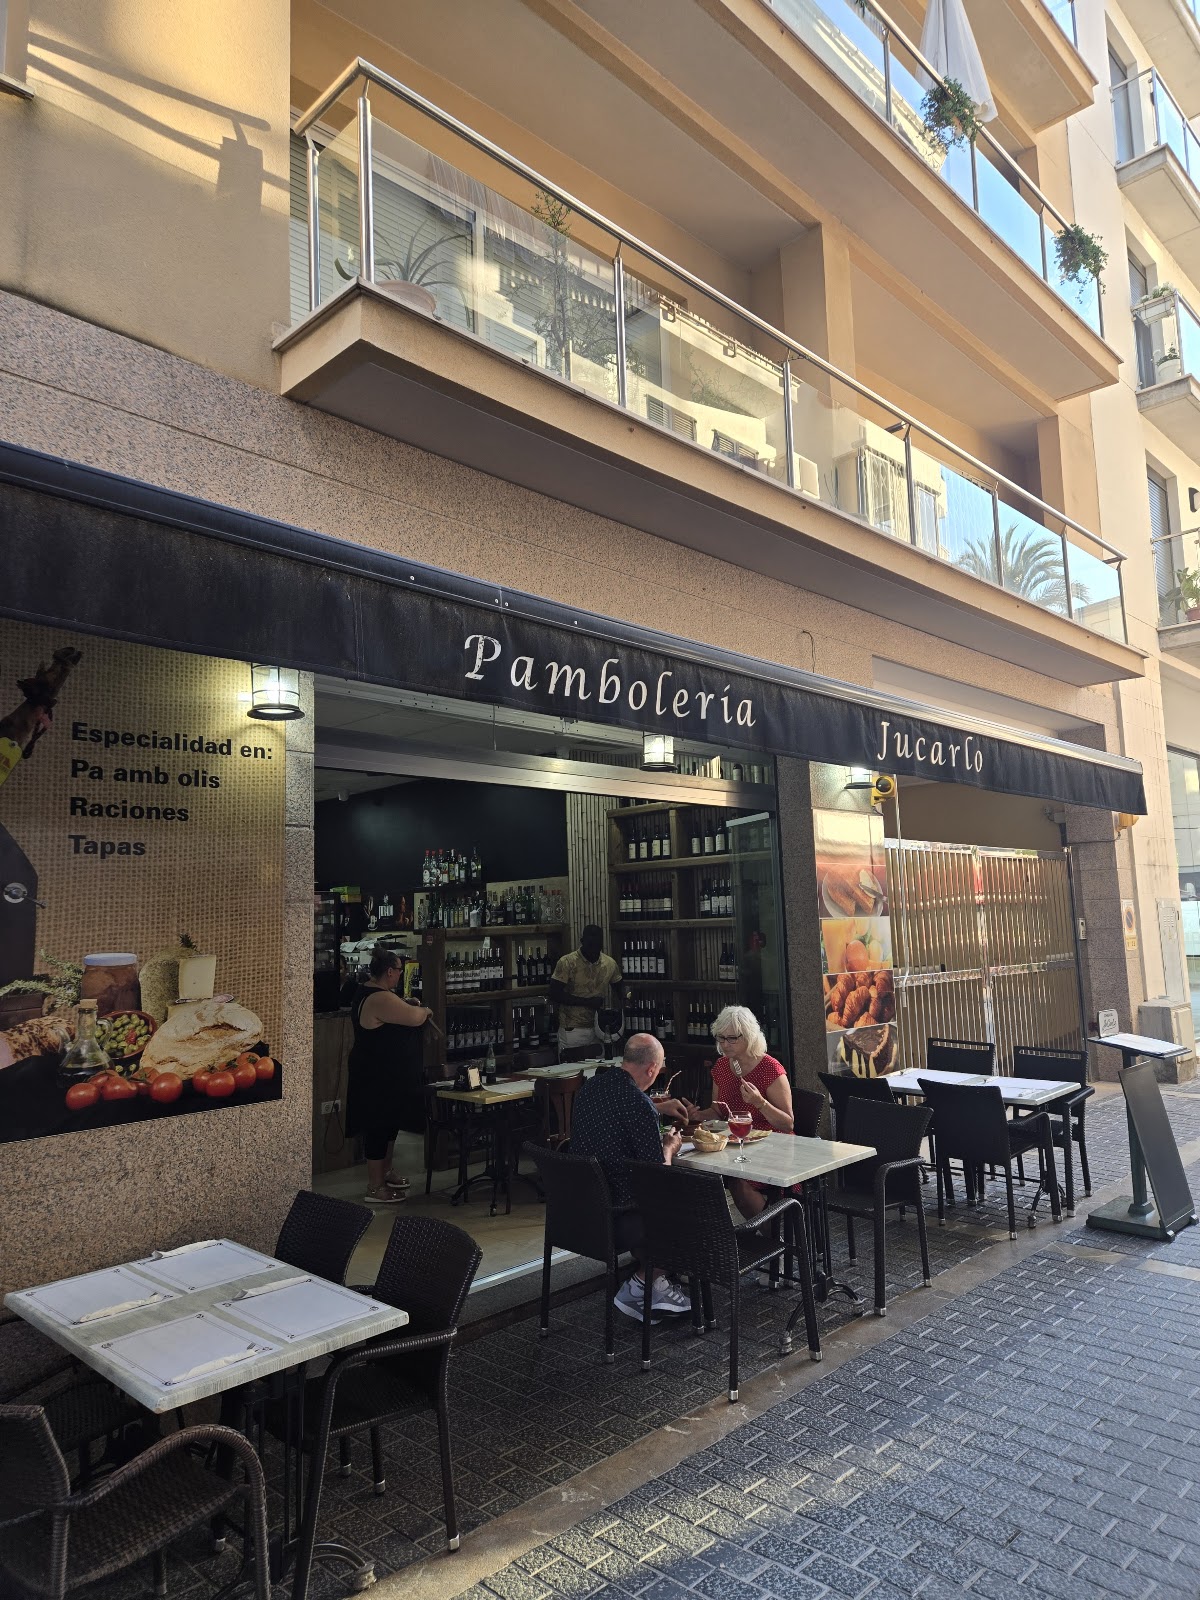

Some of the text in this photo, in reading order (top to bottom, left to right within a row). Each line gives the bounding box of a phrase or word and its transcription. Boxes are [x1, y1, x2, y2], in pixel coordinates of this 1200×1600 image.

[464, 634, 983, 773] Pambolería Jucarlo
[71, 722, 273, 759] Especialidad en:
[71, 759, 220, 788] Pa amb olis
[70, 797, 189, 822] Raciones
[68, 835, 146, 860] Tapas
